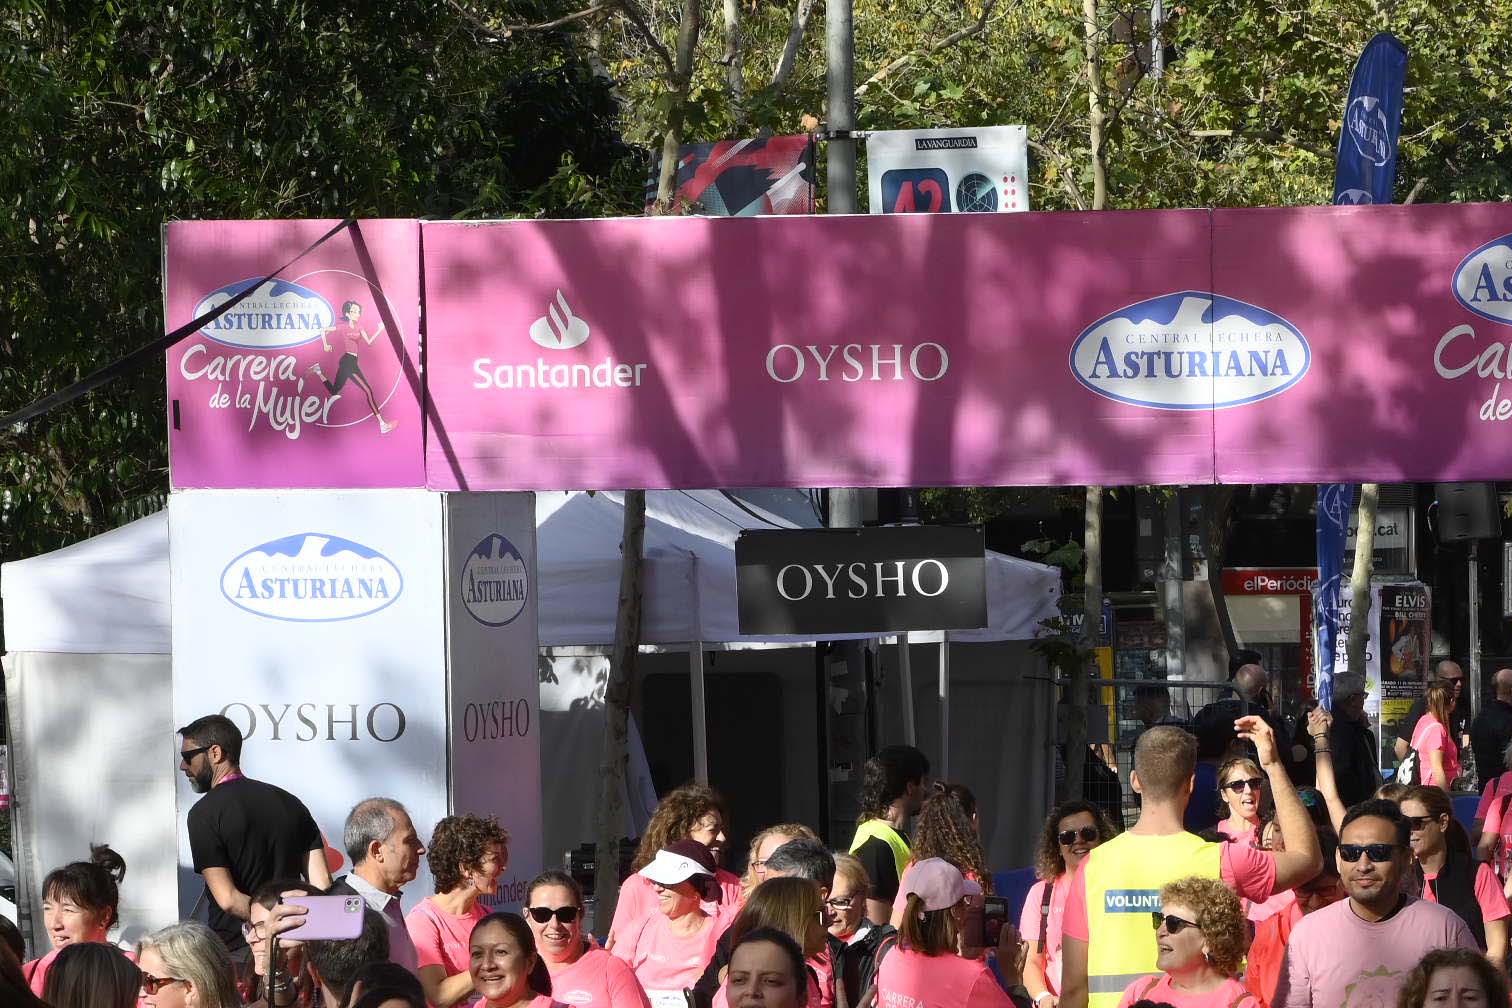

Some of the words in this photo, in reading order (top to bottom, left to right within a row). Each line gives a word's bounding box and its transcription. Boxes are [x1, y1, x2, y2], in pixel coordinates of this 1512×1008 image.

[204, 303, 323, 331] ASTURIANA
[1125, 333, 1200, 343] CENTRAL
[1207, 330, 1284, 343] LECHERA
[180, 344, 297, 381] Carrera
[473, 358, 647, 388] Santander
[766, 342, 949, 383] OYSHO
[1089, 336, 1292, 380] ASTURIANA
[209, 383, 231, 409] de
[235, 383, 251, 409] la
[248, 378, 342, 440] Mujer
[235, 566, 390, 600] ASTURIANA
[467, 568, 528, 603] ASTURIANA
[777, 559, 949, 600] OYSHO
[1395, 595, 1426, 608] ELVIS
[220, 703, 406, 742] OYSHO
[464, 699, 529, 742] OYSHO
[1106, 895, 1161, 907] VOLUNT
